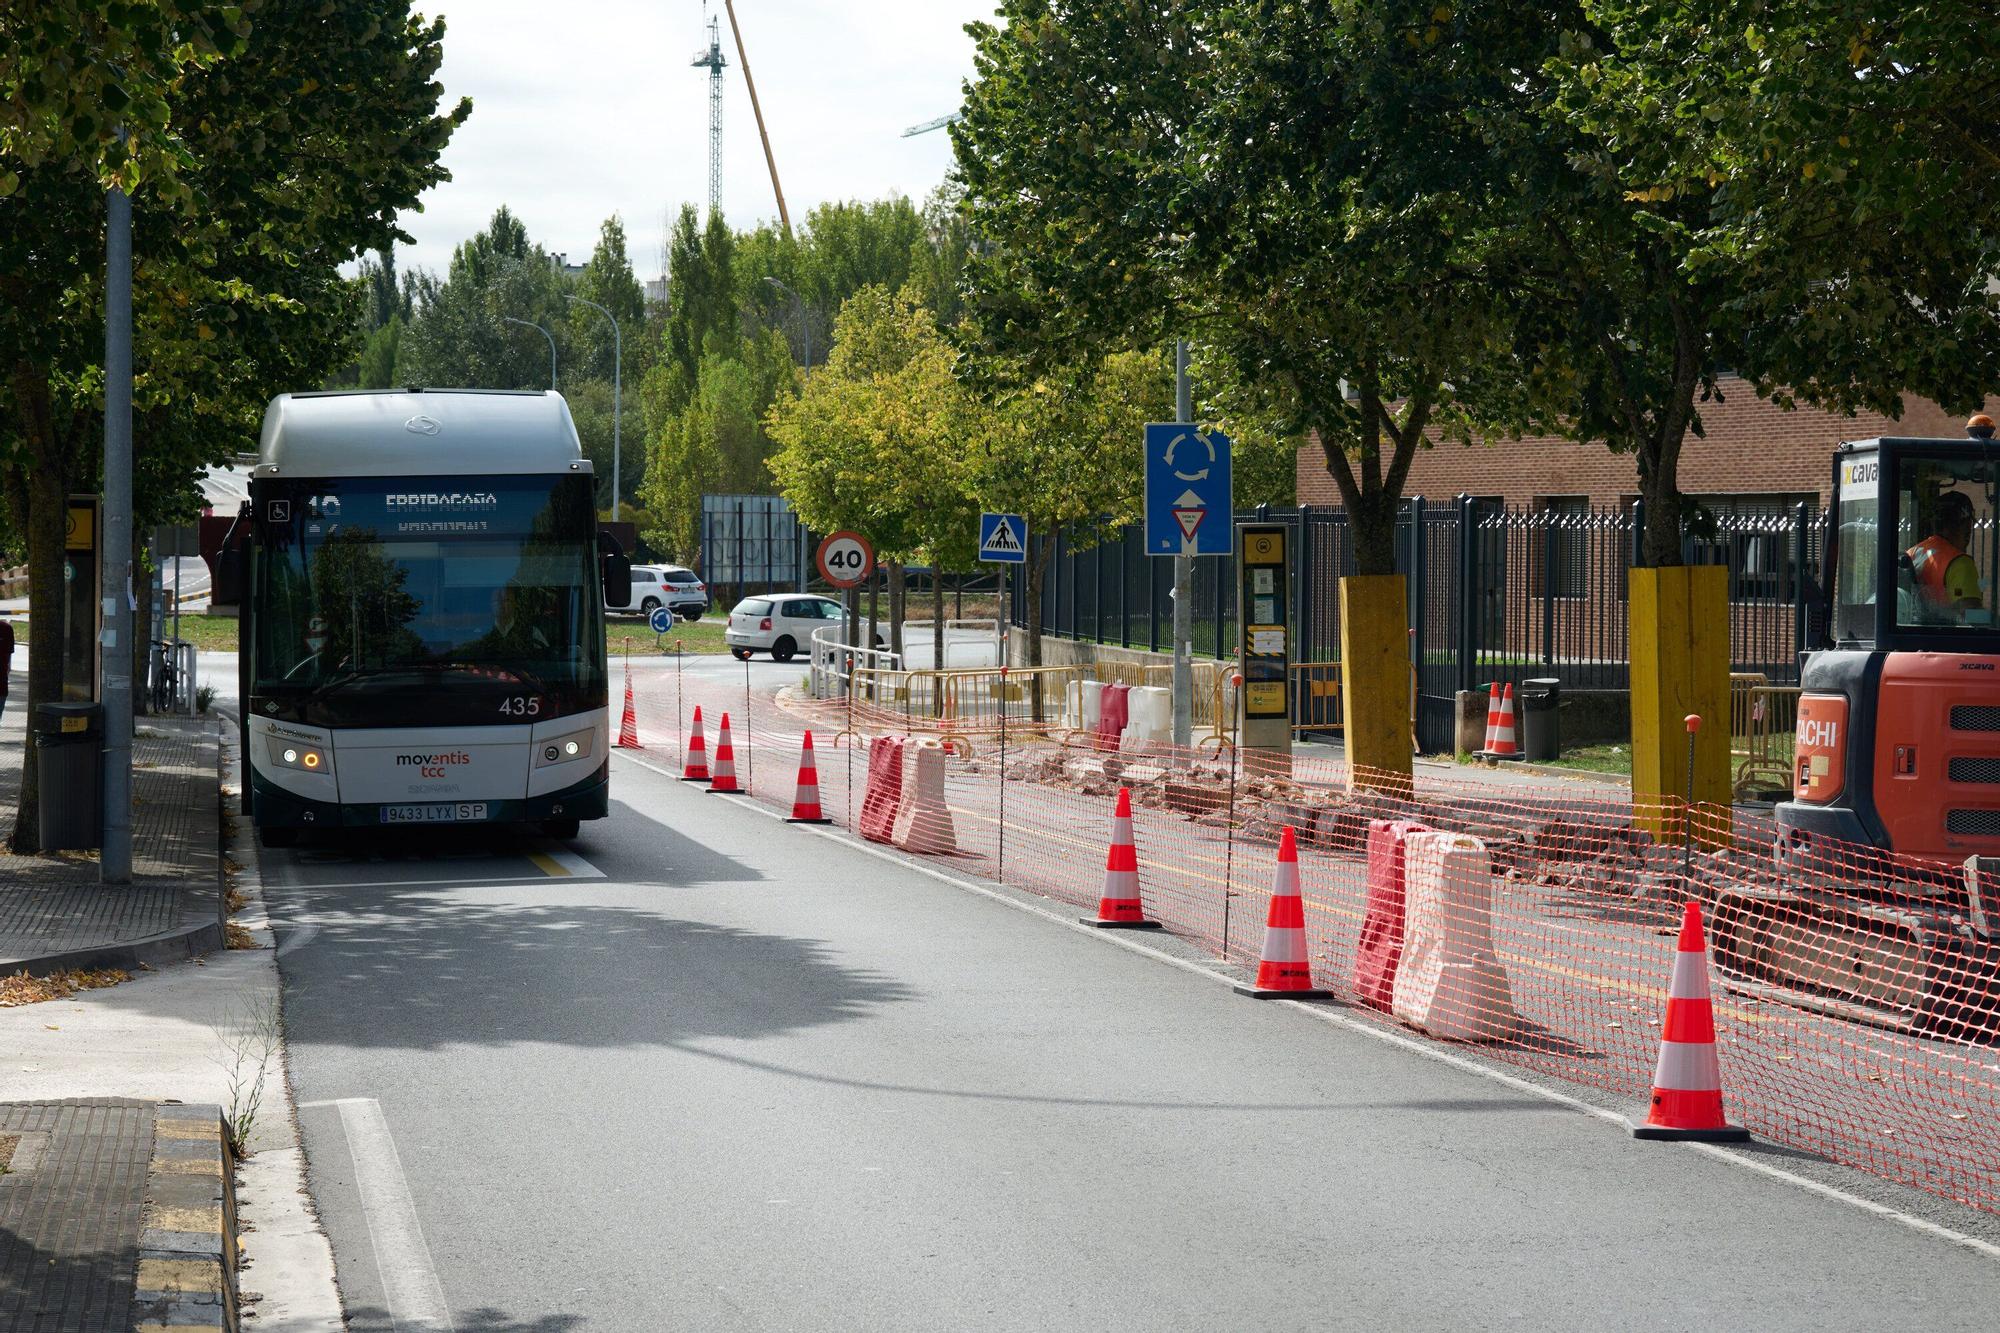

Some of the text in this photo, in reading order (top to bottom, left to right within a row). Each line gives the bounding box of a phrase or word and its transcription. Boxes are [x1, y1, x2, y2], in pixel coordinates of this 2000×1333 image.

[828, 550, 862, 569] 40
[498, 697, 540, 715] 435
[396, 750, 471, 765] moventis
[421, 766, 446, 777] tcc
[389, 805, 484, 820] 9433 LYX SP
